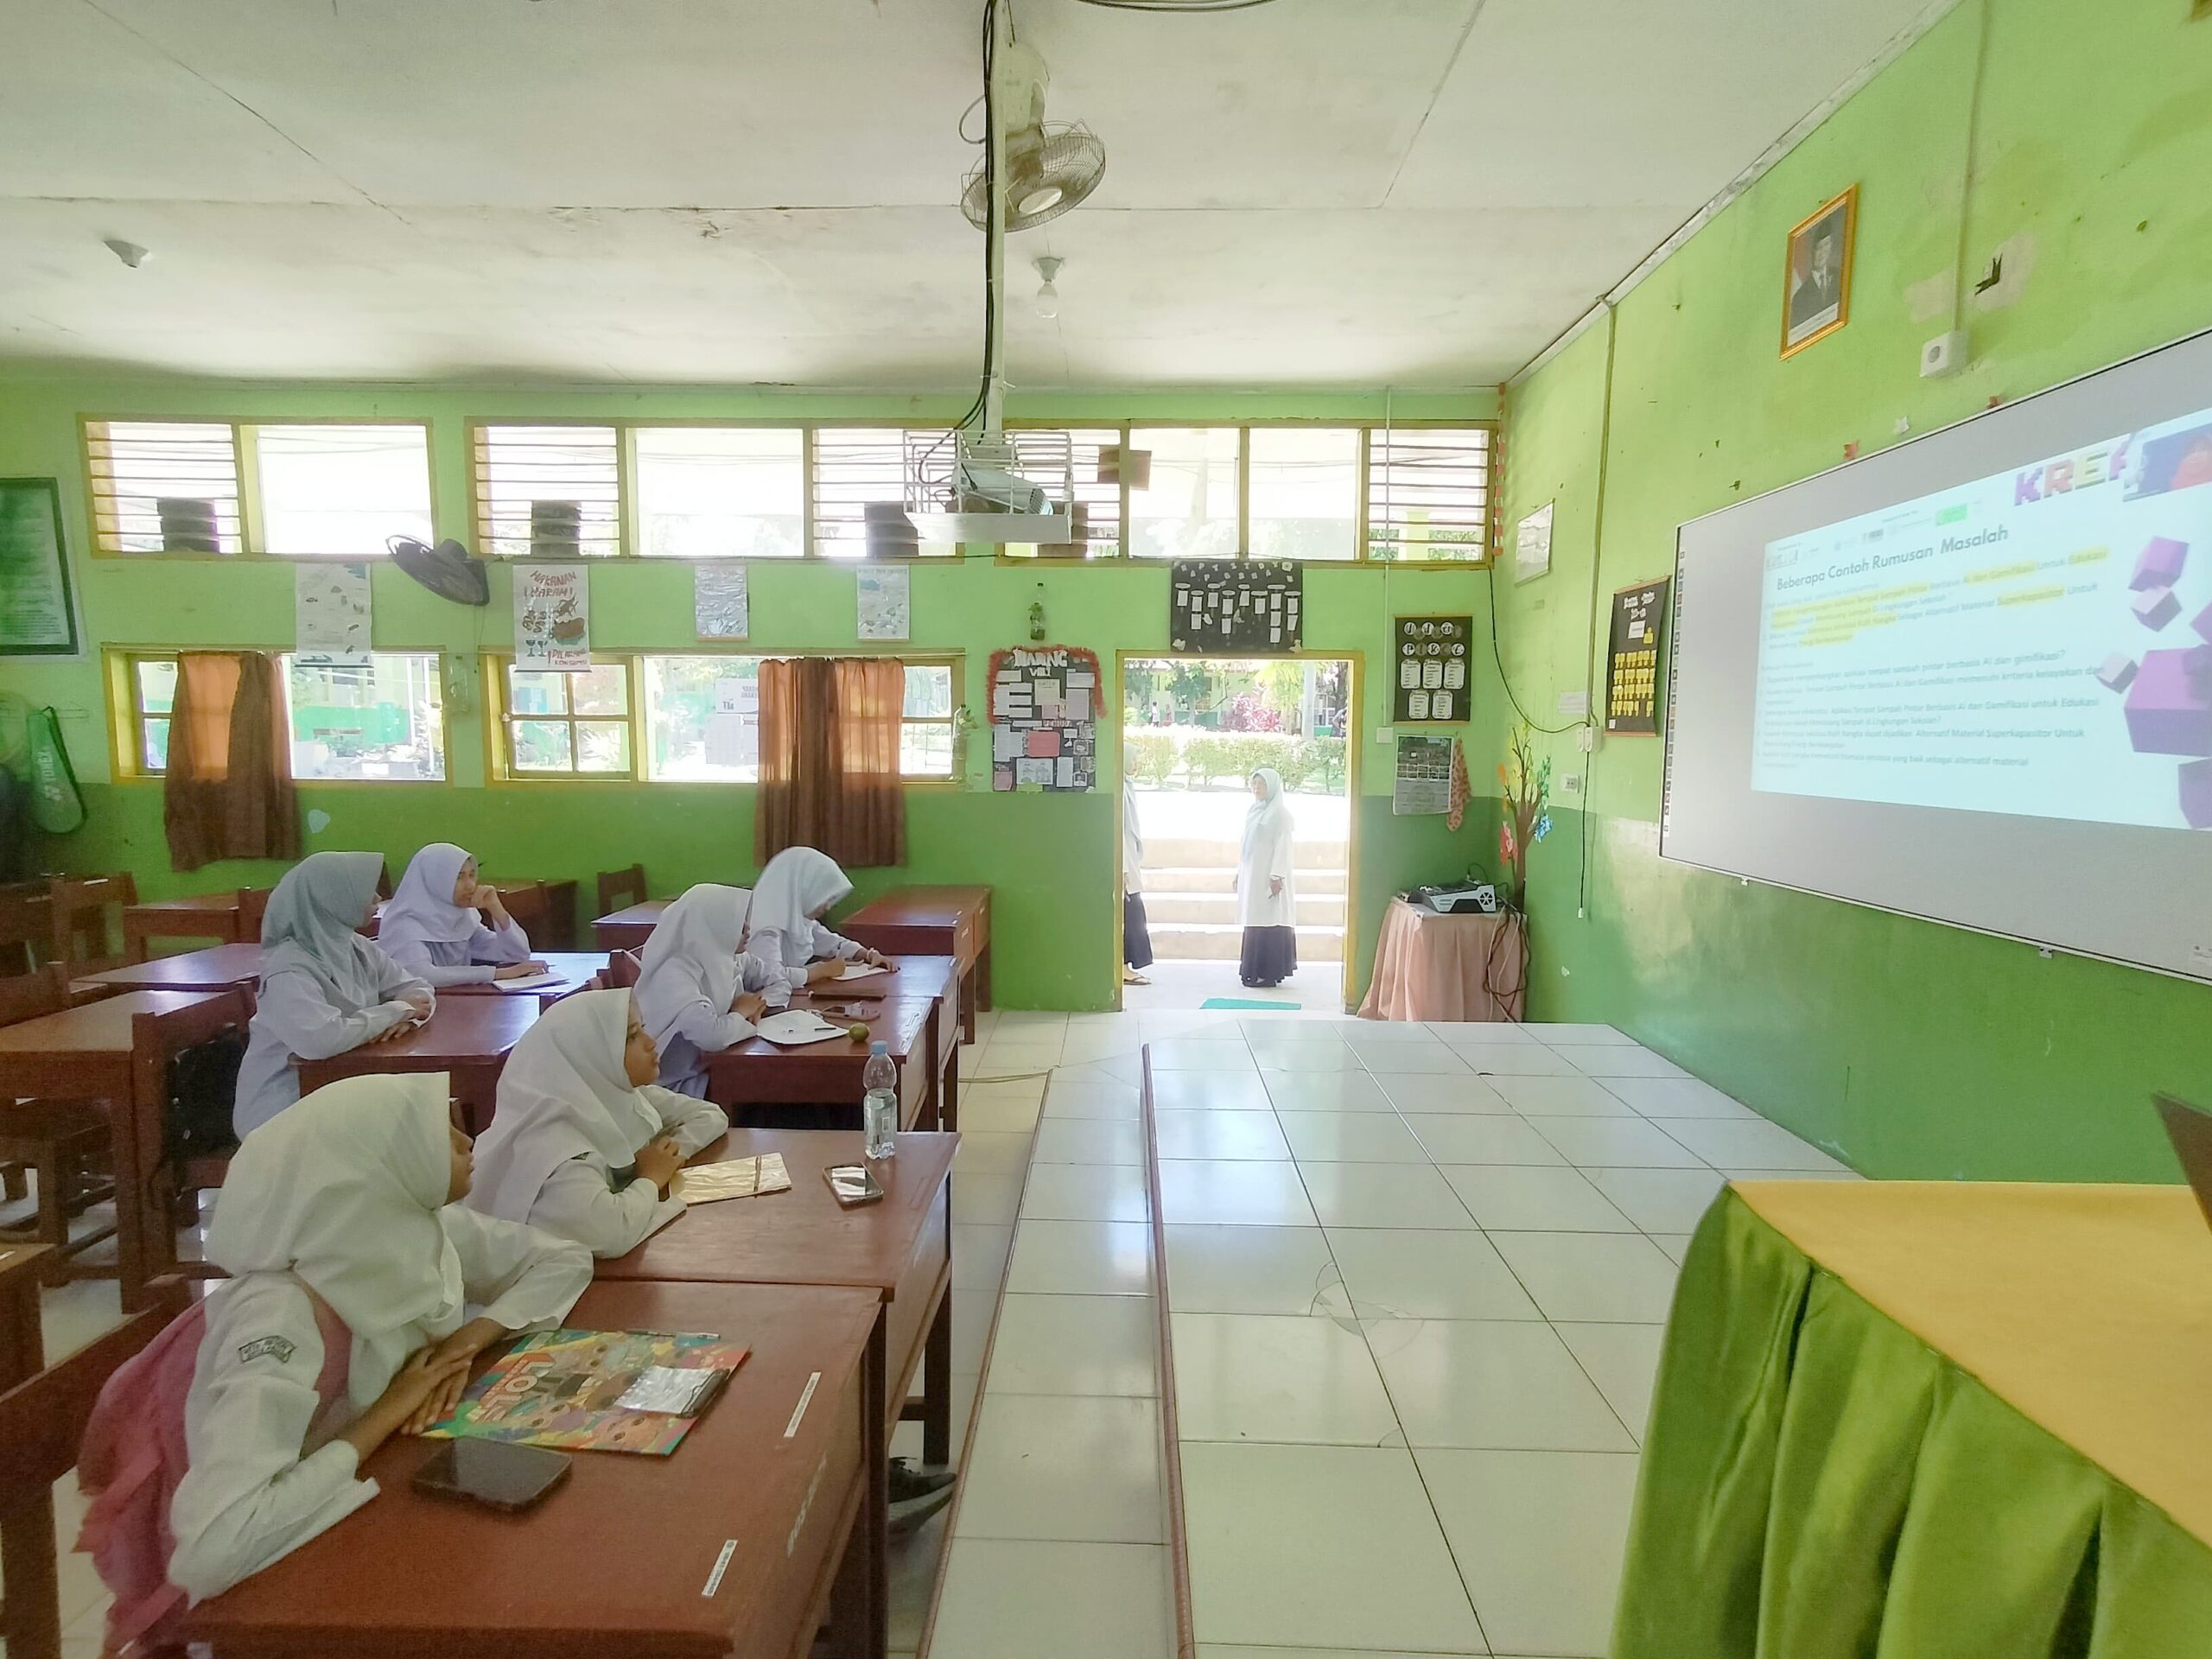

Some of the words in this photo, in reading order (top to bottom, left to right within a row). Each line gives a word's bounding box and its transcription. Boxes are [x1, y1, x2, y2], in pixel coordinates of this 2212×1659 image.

[1777, 567, 1825, 594] Beberapa
[1827, 556, 1869, 581] Contoh
[1872, 540, 1933, 570] Rumusan
[1940, 522, 2008, 555] Masalah
[2037, 555, 2065, 571] Untuk
[529, 570, 577, 586] MAKANAN
[2067, 580, 2098, 596] Untuk
[1922, 660, 1943, 671] pintar
[1994, 653, 2011, 666] dan
[1967, 700, 1983, 711] dan
[2031, 696, 2057, 709] untuk
[2061, 695, 2098, 709] Edukasi
[1916, 728, 1949, 738] Alternatif
[1951, 727, 1983, 739] Material
[2054, 726, 2084, 739] Untuk
[1910, 753, 1923, 764] baik
[1993, 754, 2028, 767] material
